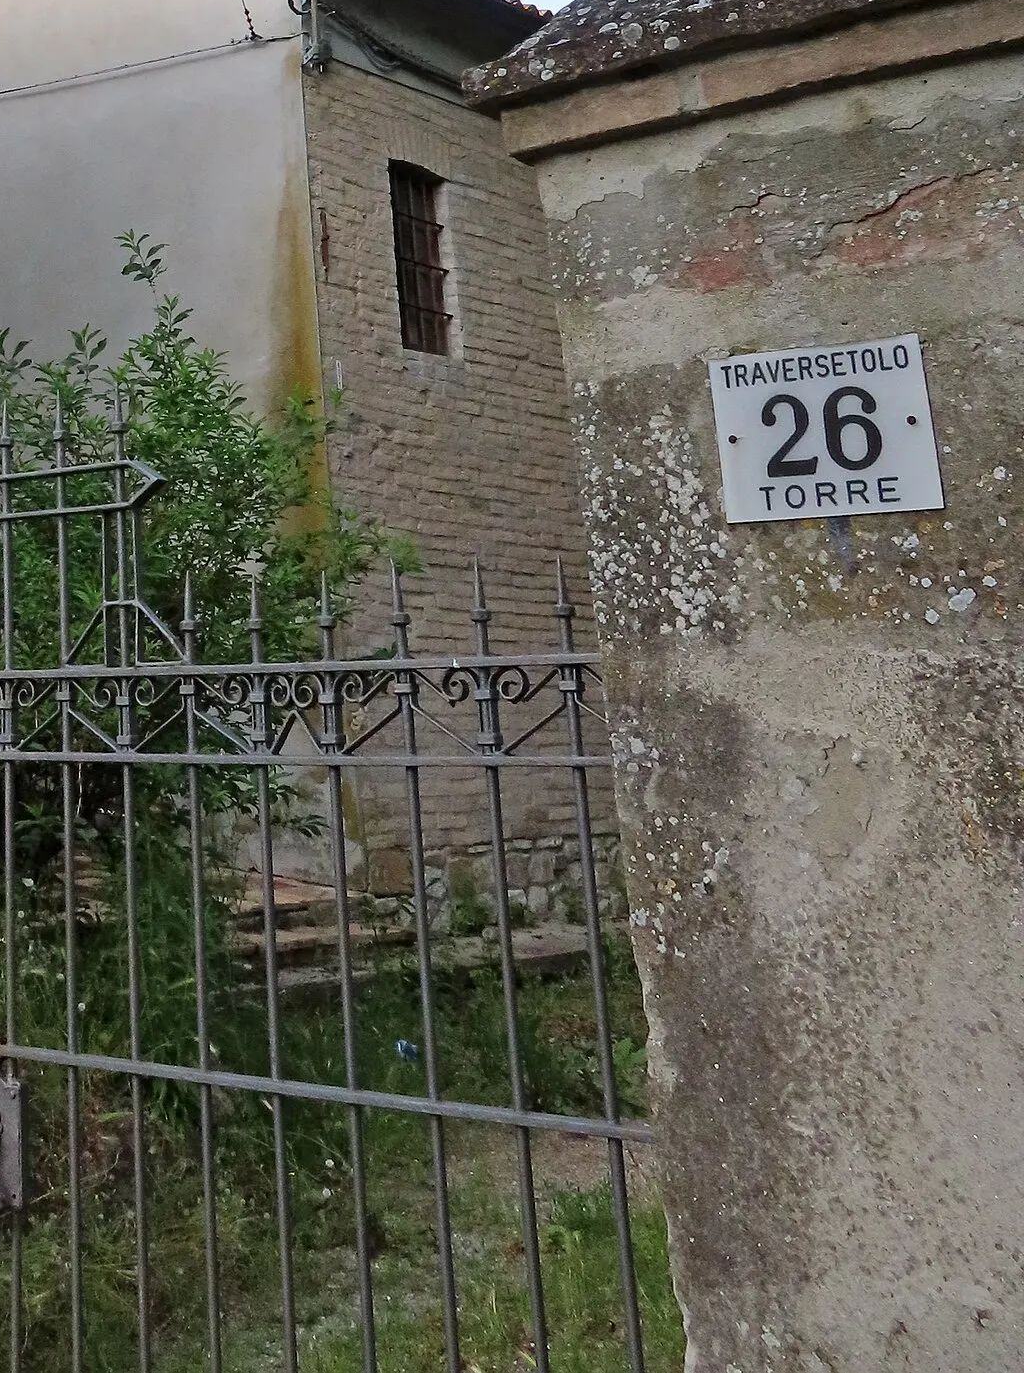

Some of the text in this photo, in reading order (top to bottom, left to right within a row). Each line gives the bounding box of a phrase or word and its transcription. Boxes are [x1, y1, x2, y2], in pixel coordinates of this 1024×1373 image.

[721, 344, 909, 388] TRAVERSETOLO
[761, 386, 882, 478] 26
[759, 477, 901, 511] TORRE
